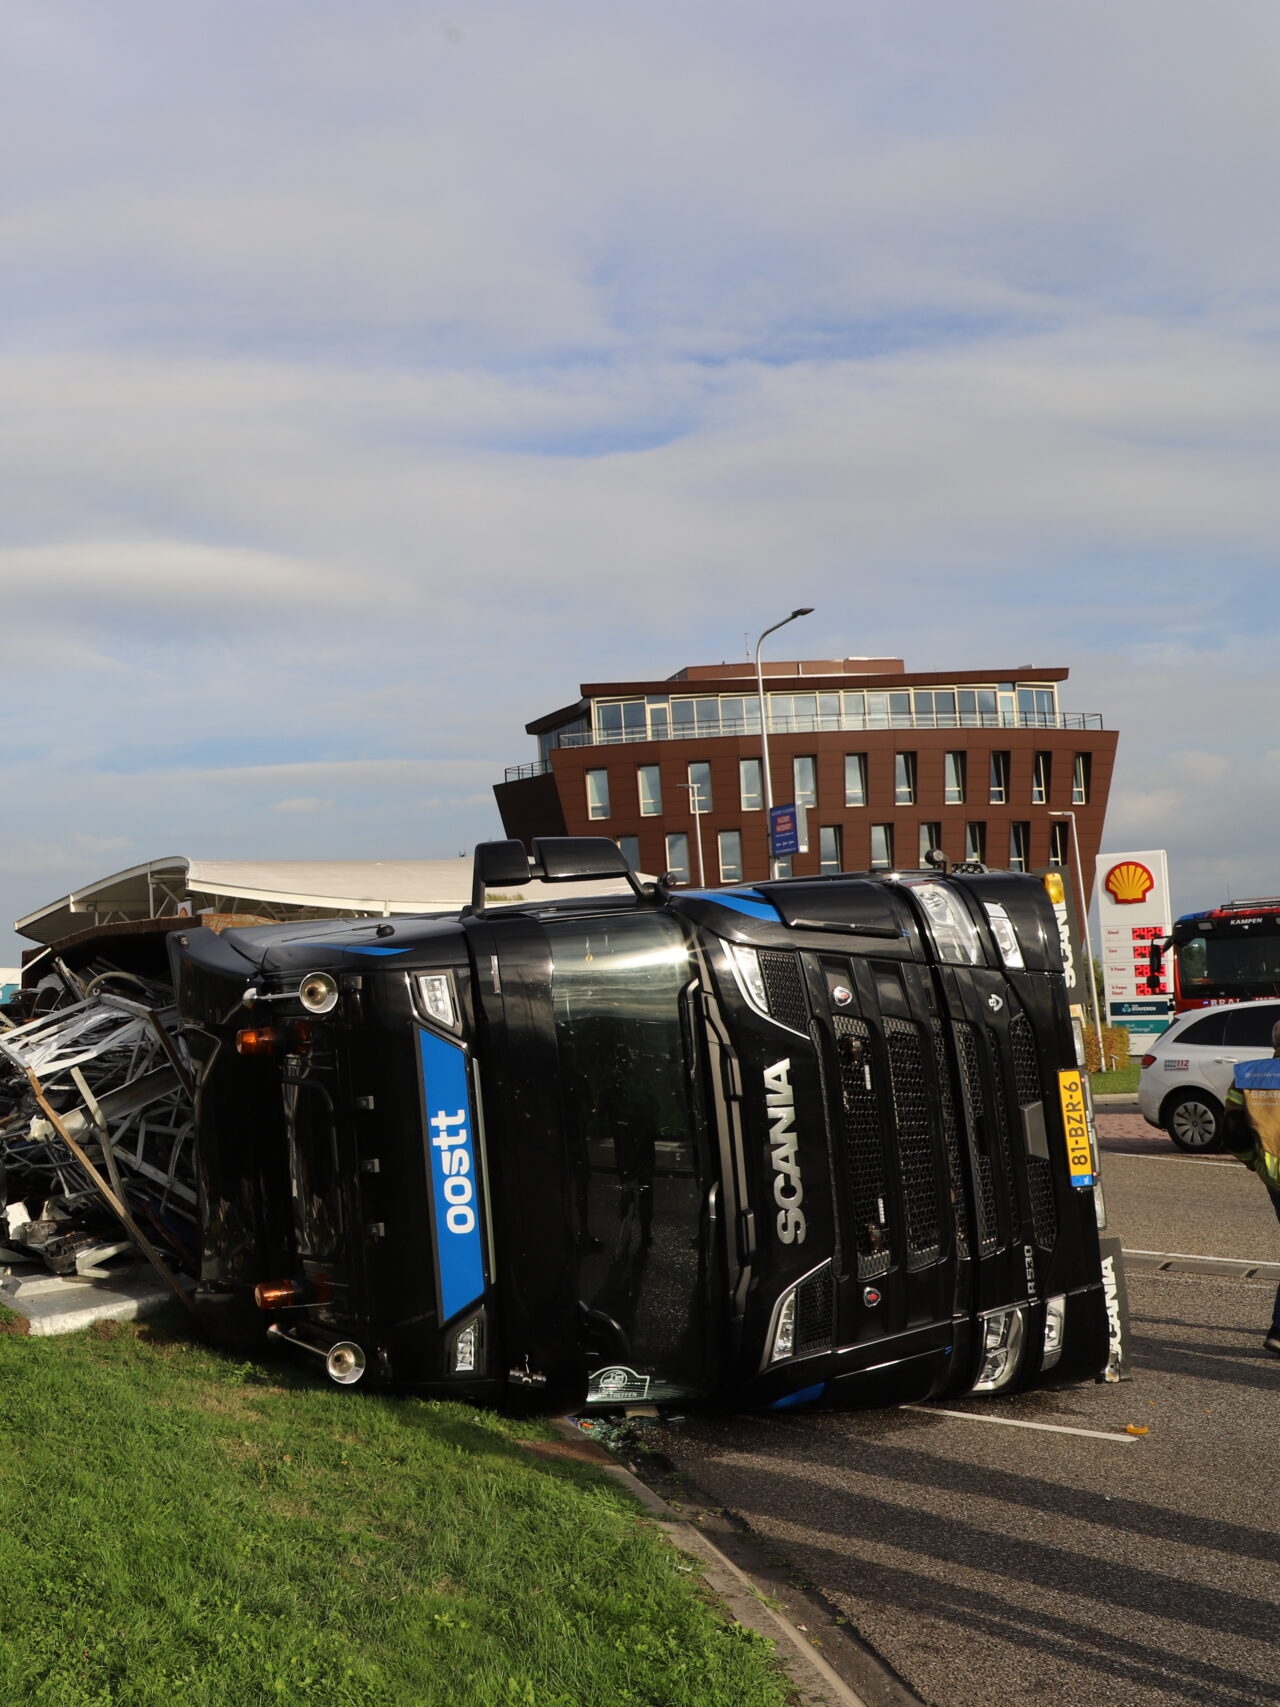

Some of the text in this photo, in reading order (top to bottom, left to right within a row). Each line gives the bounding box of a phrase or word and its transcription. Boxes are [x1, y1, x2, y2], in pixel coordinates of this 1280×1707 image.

[1176, 1059, 1189, 1067] 112
[431, 1109, 475, 1234] oostt
[763, 1057, 807, 1245] SCANIA
[1063, 1080, 1088, 1166] 81-BZR-6
